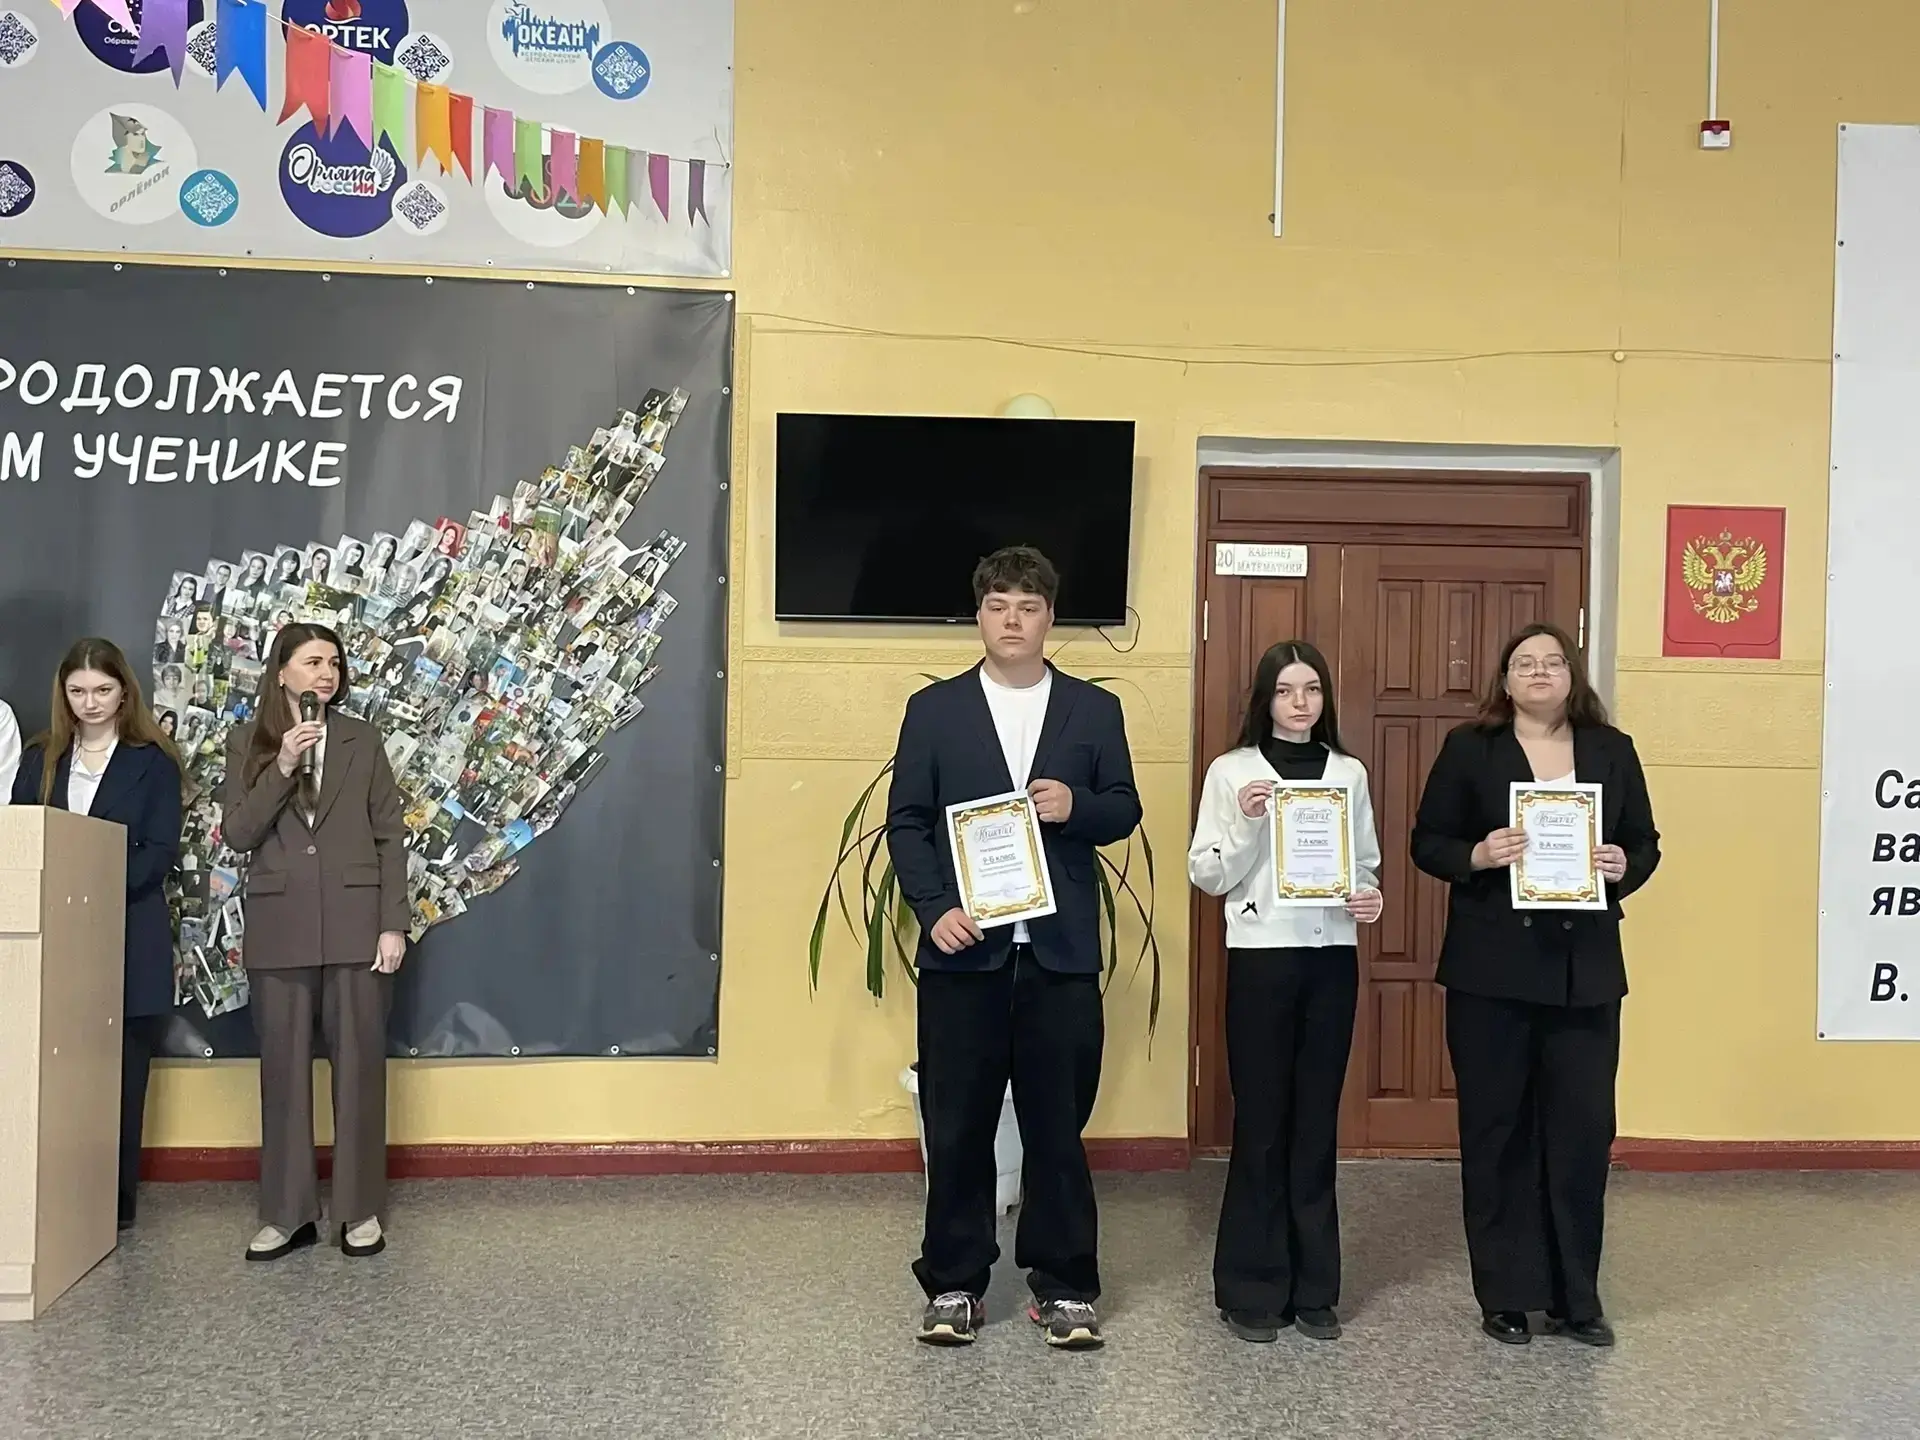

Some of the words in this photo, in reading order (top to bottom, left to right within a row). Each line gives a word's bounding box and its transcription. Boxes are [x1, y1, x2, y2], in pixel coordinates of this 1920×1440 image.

[518, 24, 584, 46] ОКЕАН
[290, 145, 376, 187] Орлята
[110, 165, 170, 213] ОРЛЁНОК
[0, 431, 45, 482] М
[73, 432, 347, 488] УЧЕНИКЕ
[1237, 561, 1302, 573] МАТЕМАТИКИ
[1248, 547, 1292, 560] КАБИНЕТ
[1870, 962, 1909, 1002] В.
